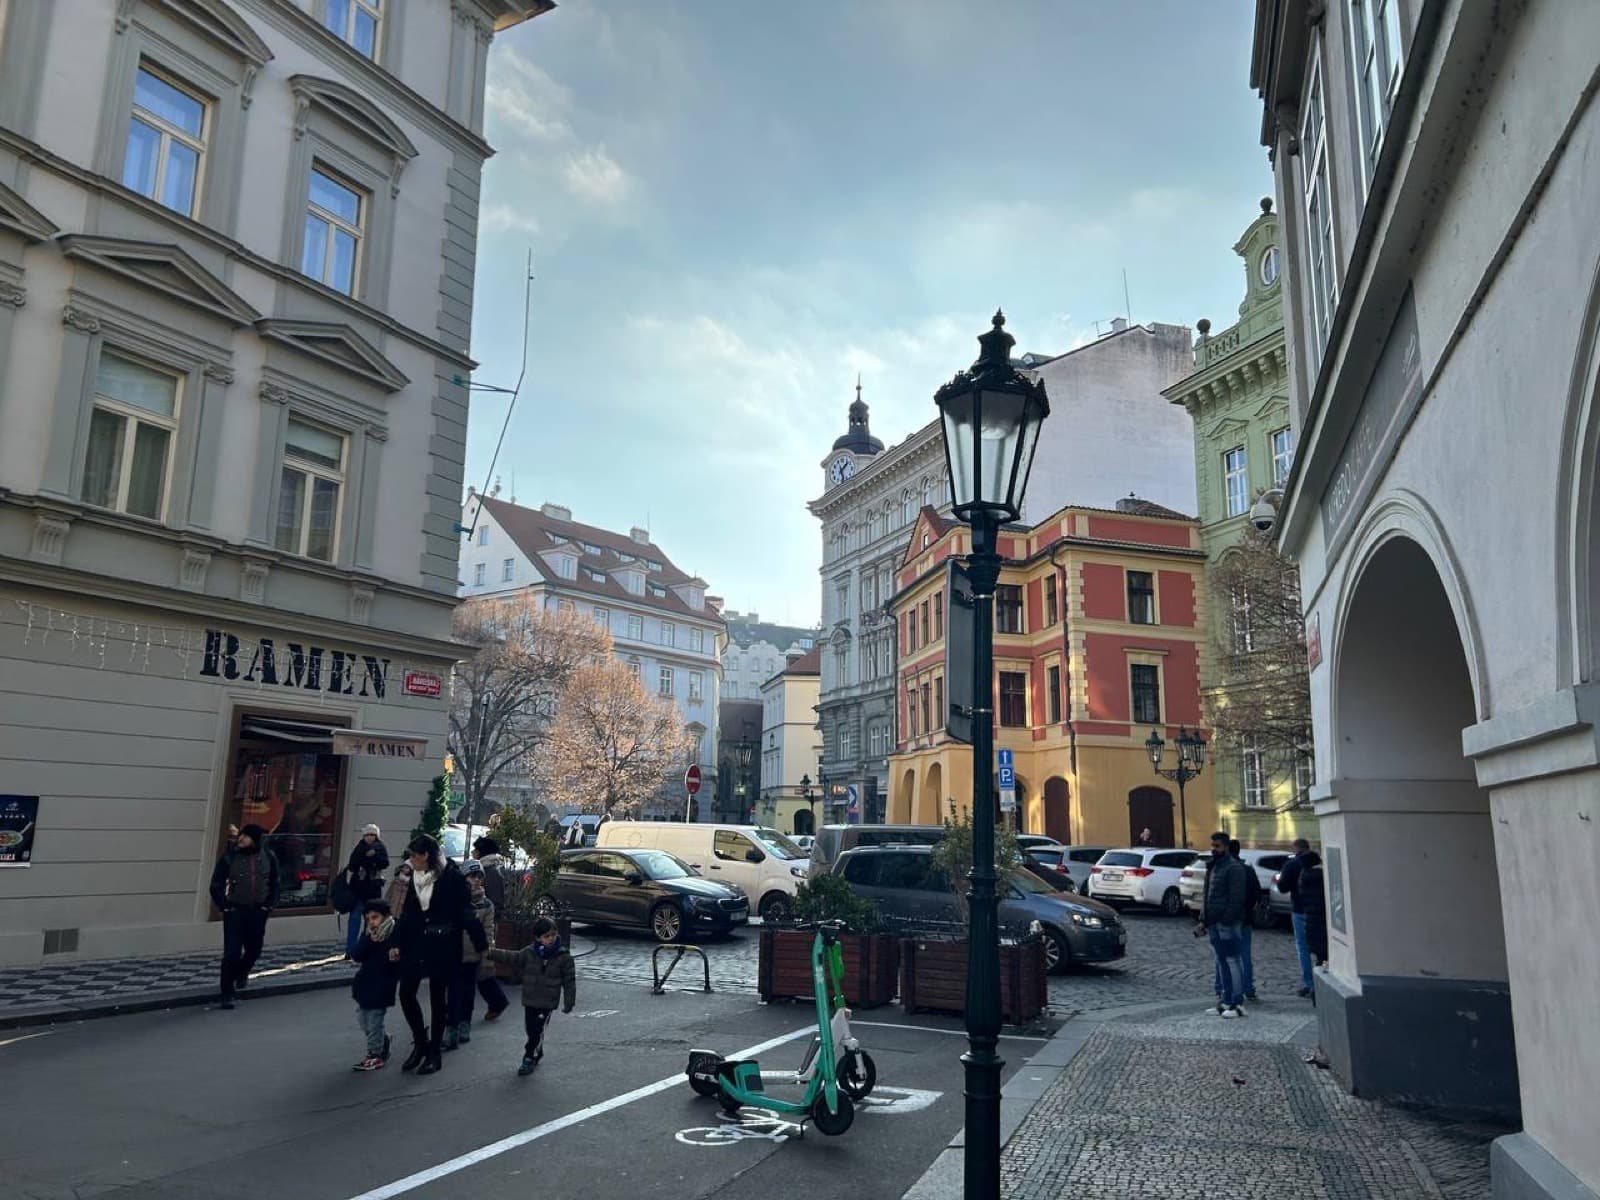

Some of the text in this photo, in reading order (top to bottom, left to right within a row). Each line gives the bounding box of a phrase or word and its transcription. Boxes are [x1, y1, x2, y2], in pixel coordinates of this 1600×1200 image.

[200, 629, 391, 698] RAMEN
[368, 743, 415, 757] RAMEN
[1001, 769, 1011, 781] P
